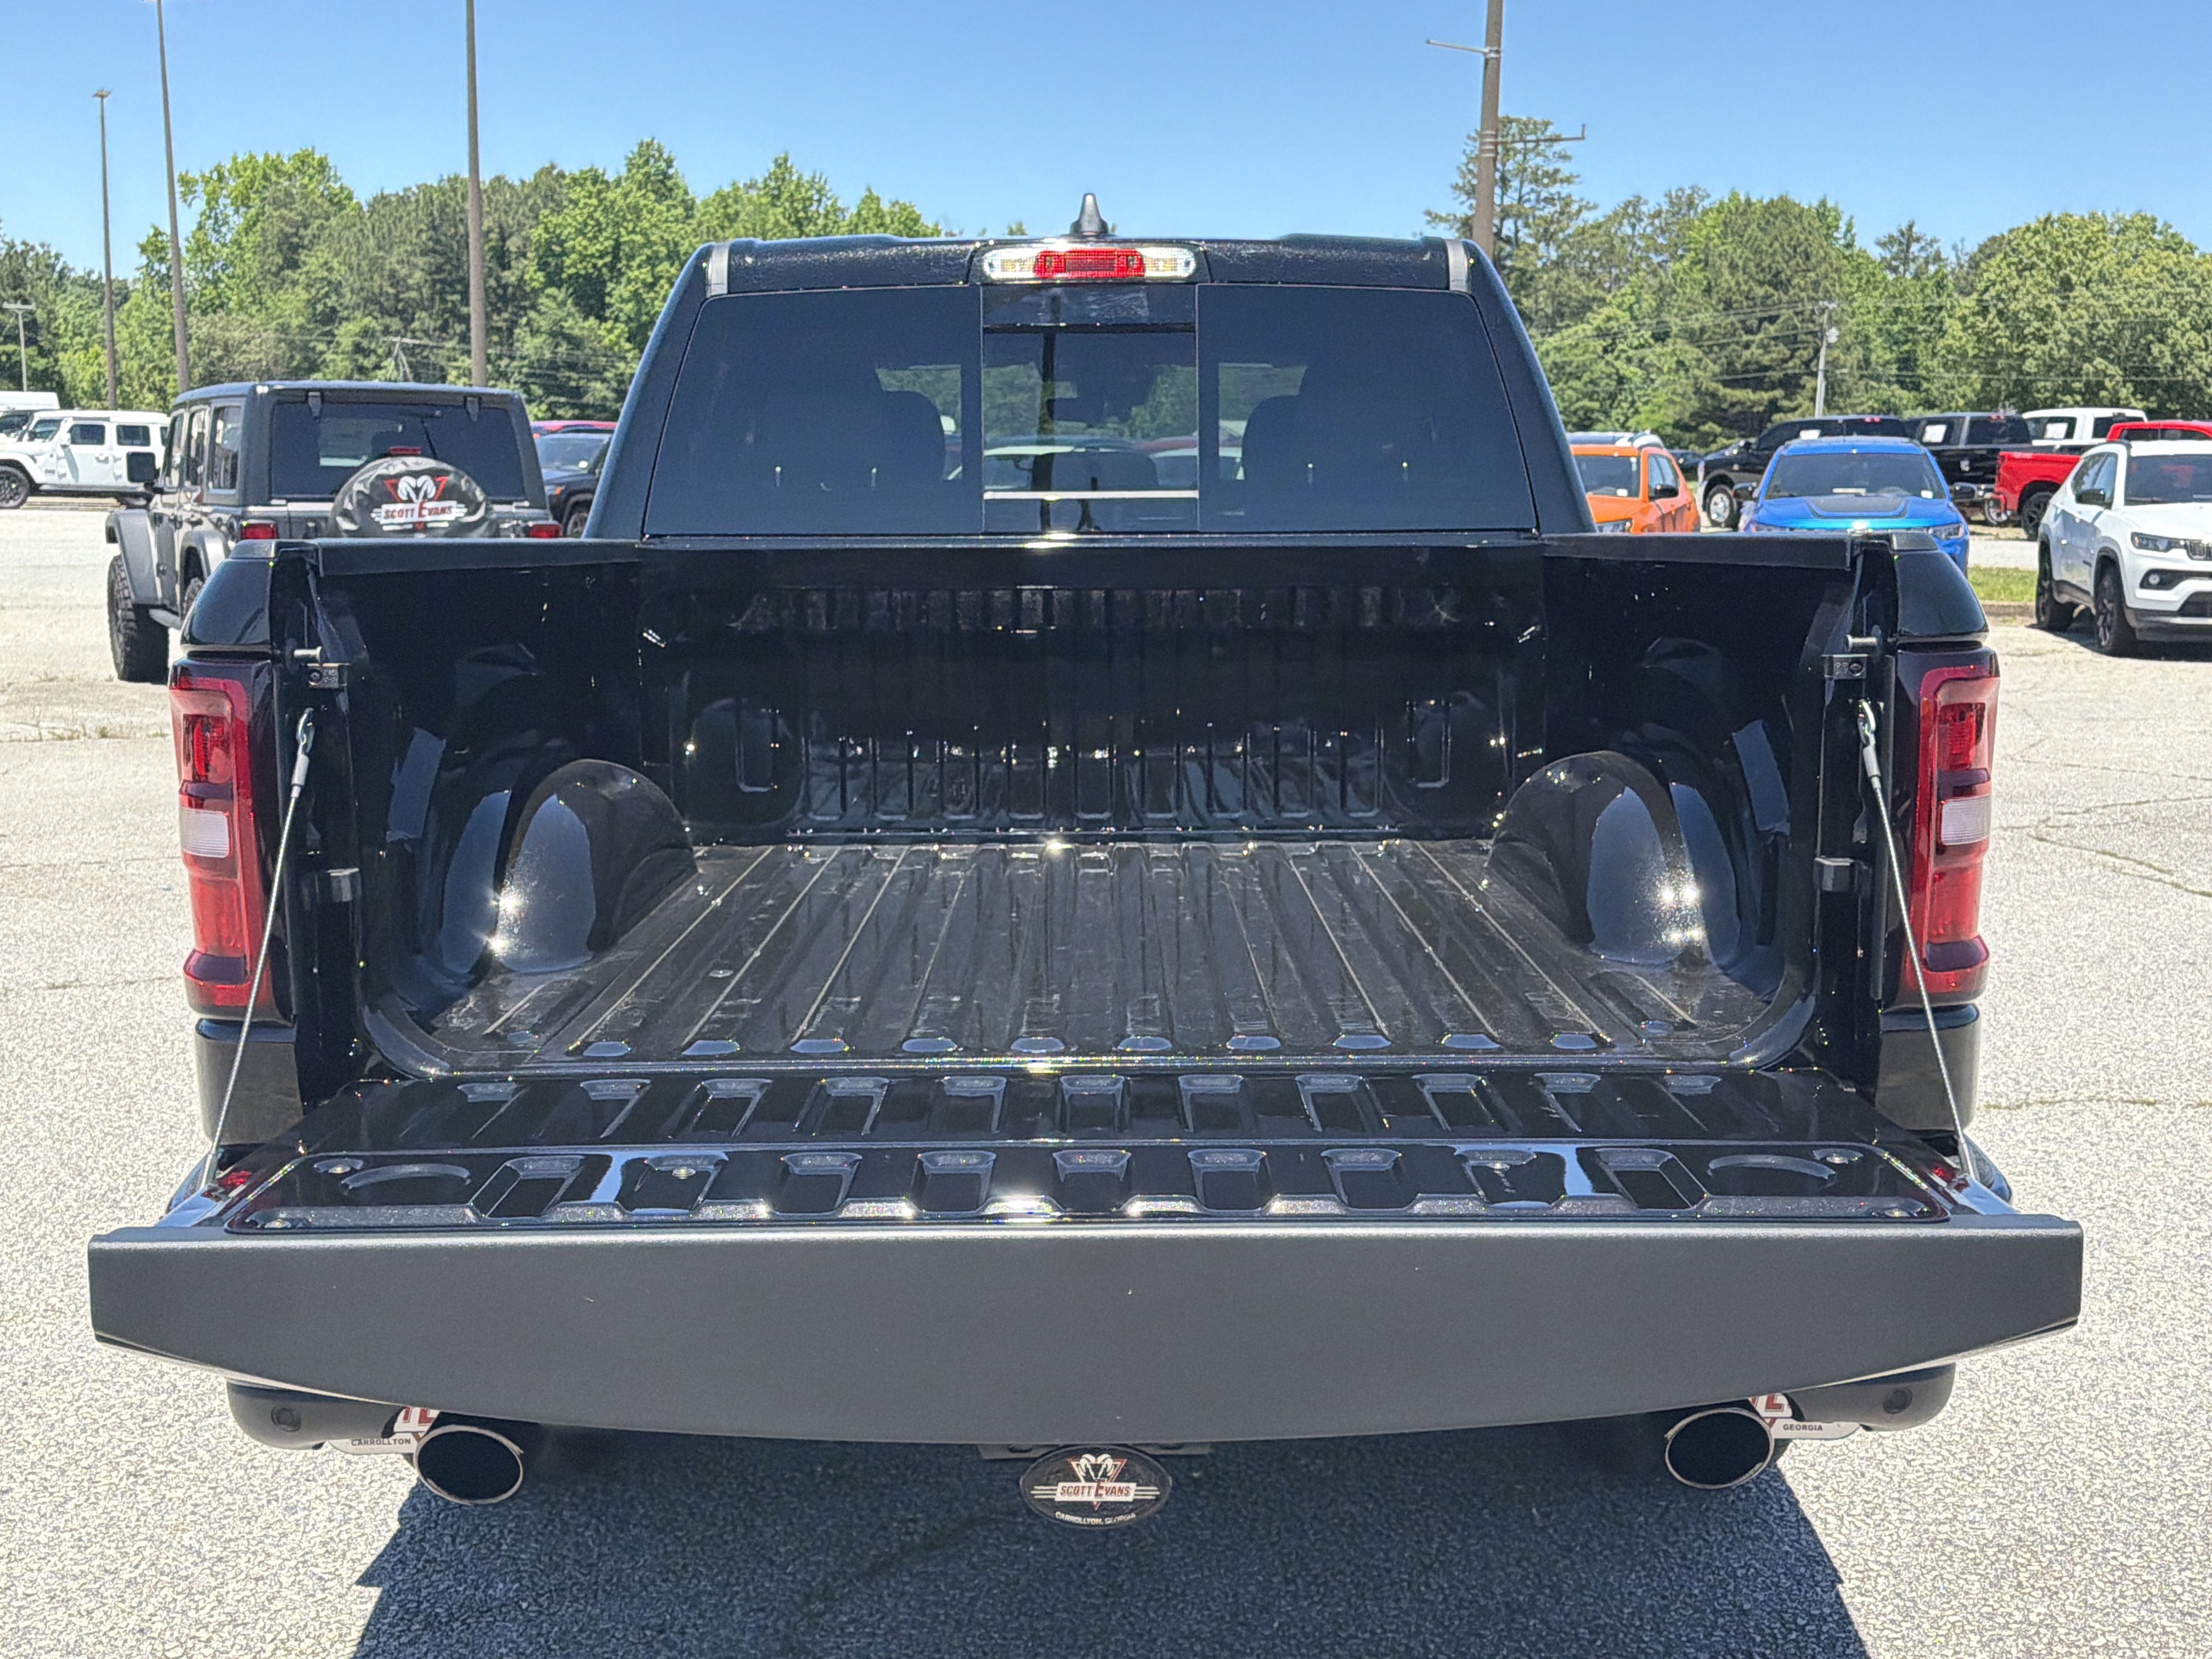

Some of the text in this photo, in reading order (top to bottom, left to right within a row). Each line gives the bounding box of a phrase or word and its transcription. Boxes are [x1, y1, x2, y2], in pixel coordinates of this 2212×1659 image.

[384, 508, 415, 520] SCOTT
[351, 1438, 411, 1446] CARROLLTON
[1060, 1480, 1132, 1498] SCOTT EVANS
